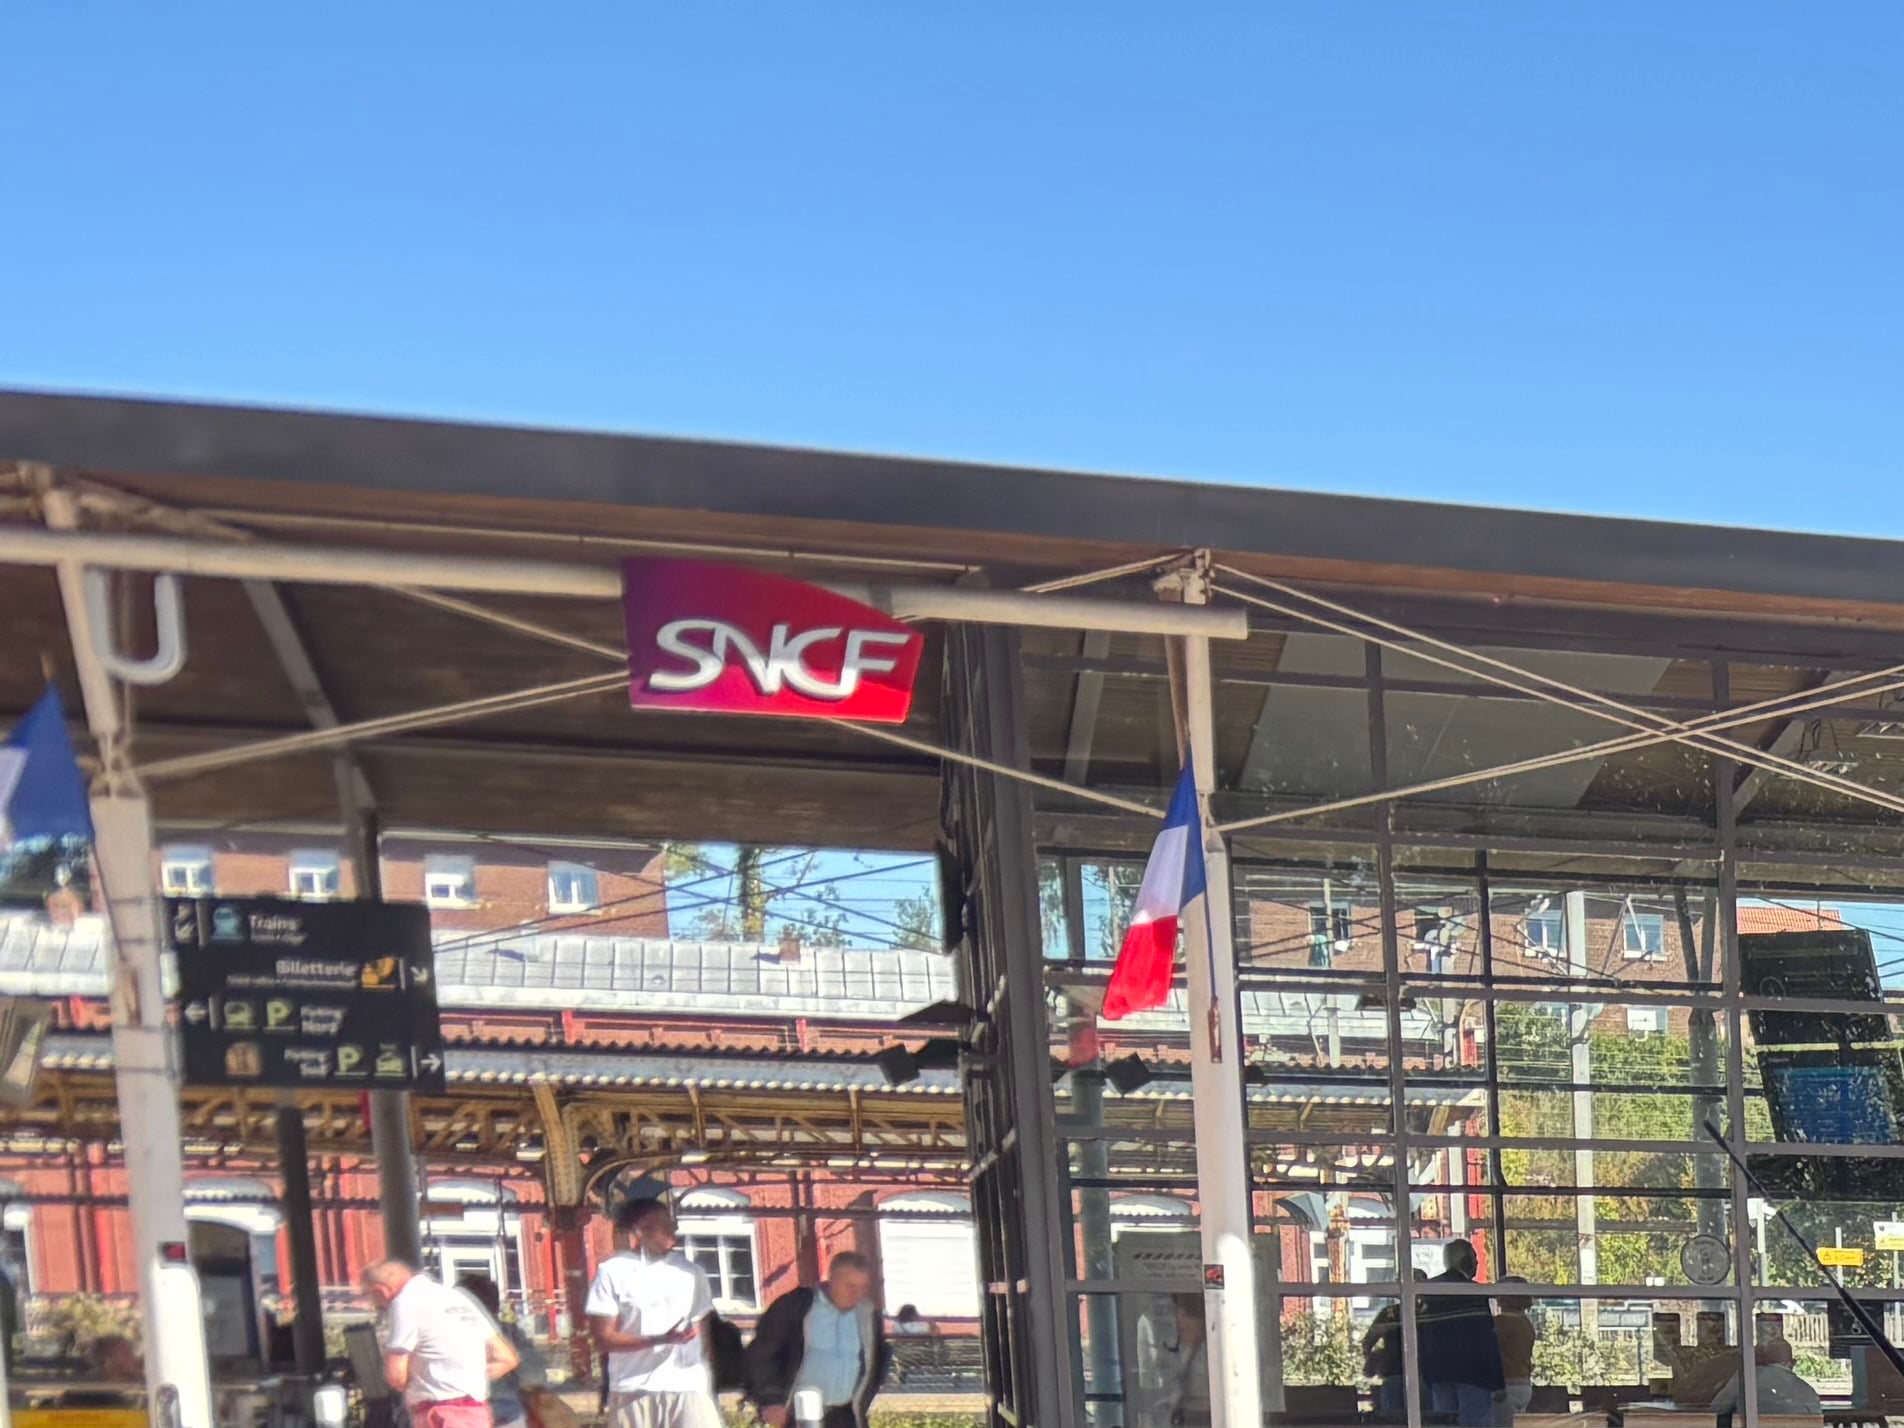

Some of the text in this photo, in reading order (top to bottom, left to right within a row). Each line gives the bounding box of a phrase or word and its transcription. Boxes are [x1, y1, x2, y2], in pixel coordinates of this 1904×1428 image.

[650, 619, 910, 697] SNCF
[249, 914, 299, 931] Trains
[275, 959, 357, 977] Billetterie
[267, 1001, 292, 1027] P
[337, 1046, 361, 1073] P
